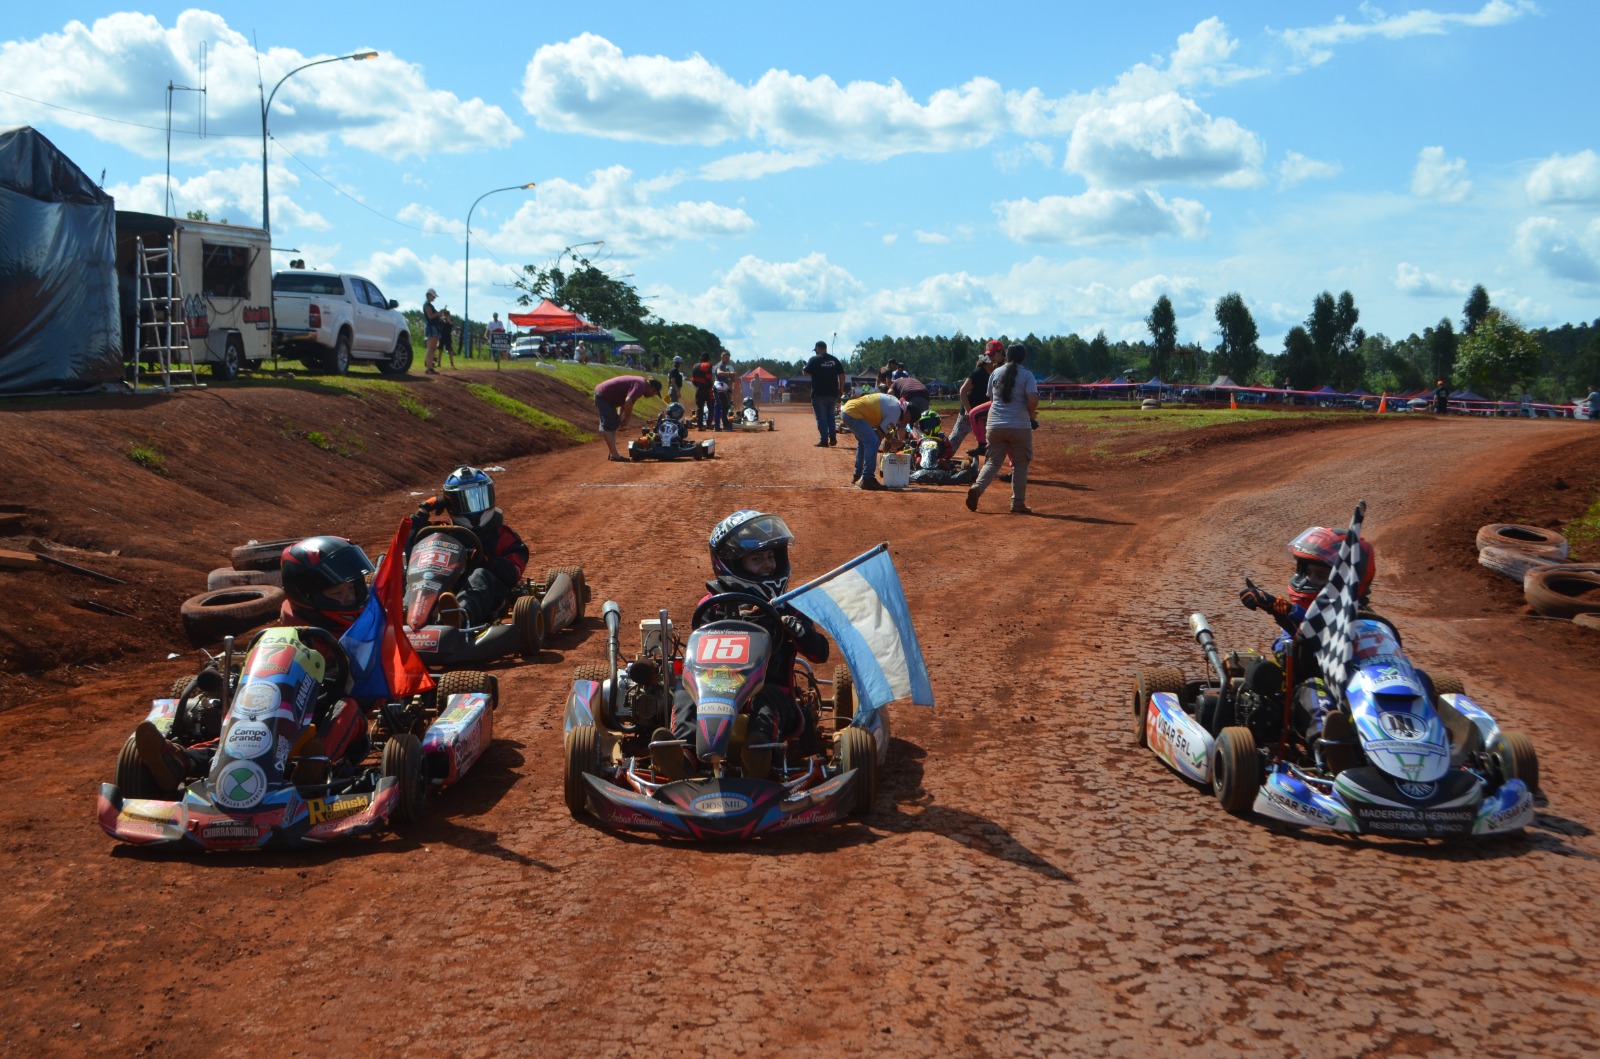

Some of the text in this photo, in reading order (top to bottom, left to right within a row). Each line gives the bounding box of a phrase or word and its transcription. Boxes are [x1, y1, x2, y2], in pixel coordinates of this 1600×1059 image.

[663, 425, 673, 434] 16
[420, 553, 447, 564] 21
[701, 637, 747, 661] 15
[234, 728, 267, 737] Campo
[1157, 714, 1191, 757] VISAR SRL
[229, 735, 262, 743] Grande
[306, 795, 369, 825] Rosinski
[702, 800, 743, 810] DOS MIL
[1301, 804, 1323, 819] SRL
[1359, 808, 1472, 821] MADERERA 3 HERMANOS
[1369, 821, 1428, 832] RESISTENCIA
[1434, 823, 1463, 832] CHACO
